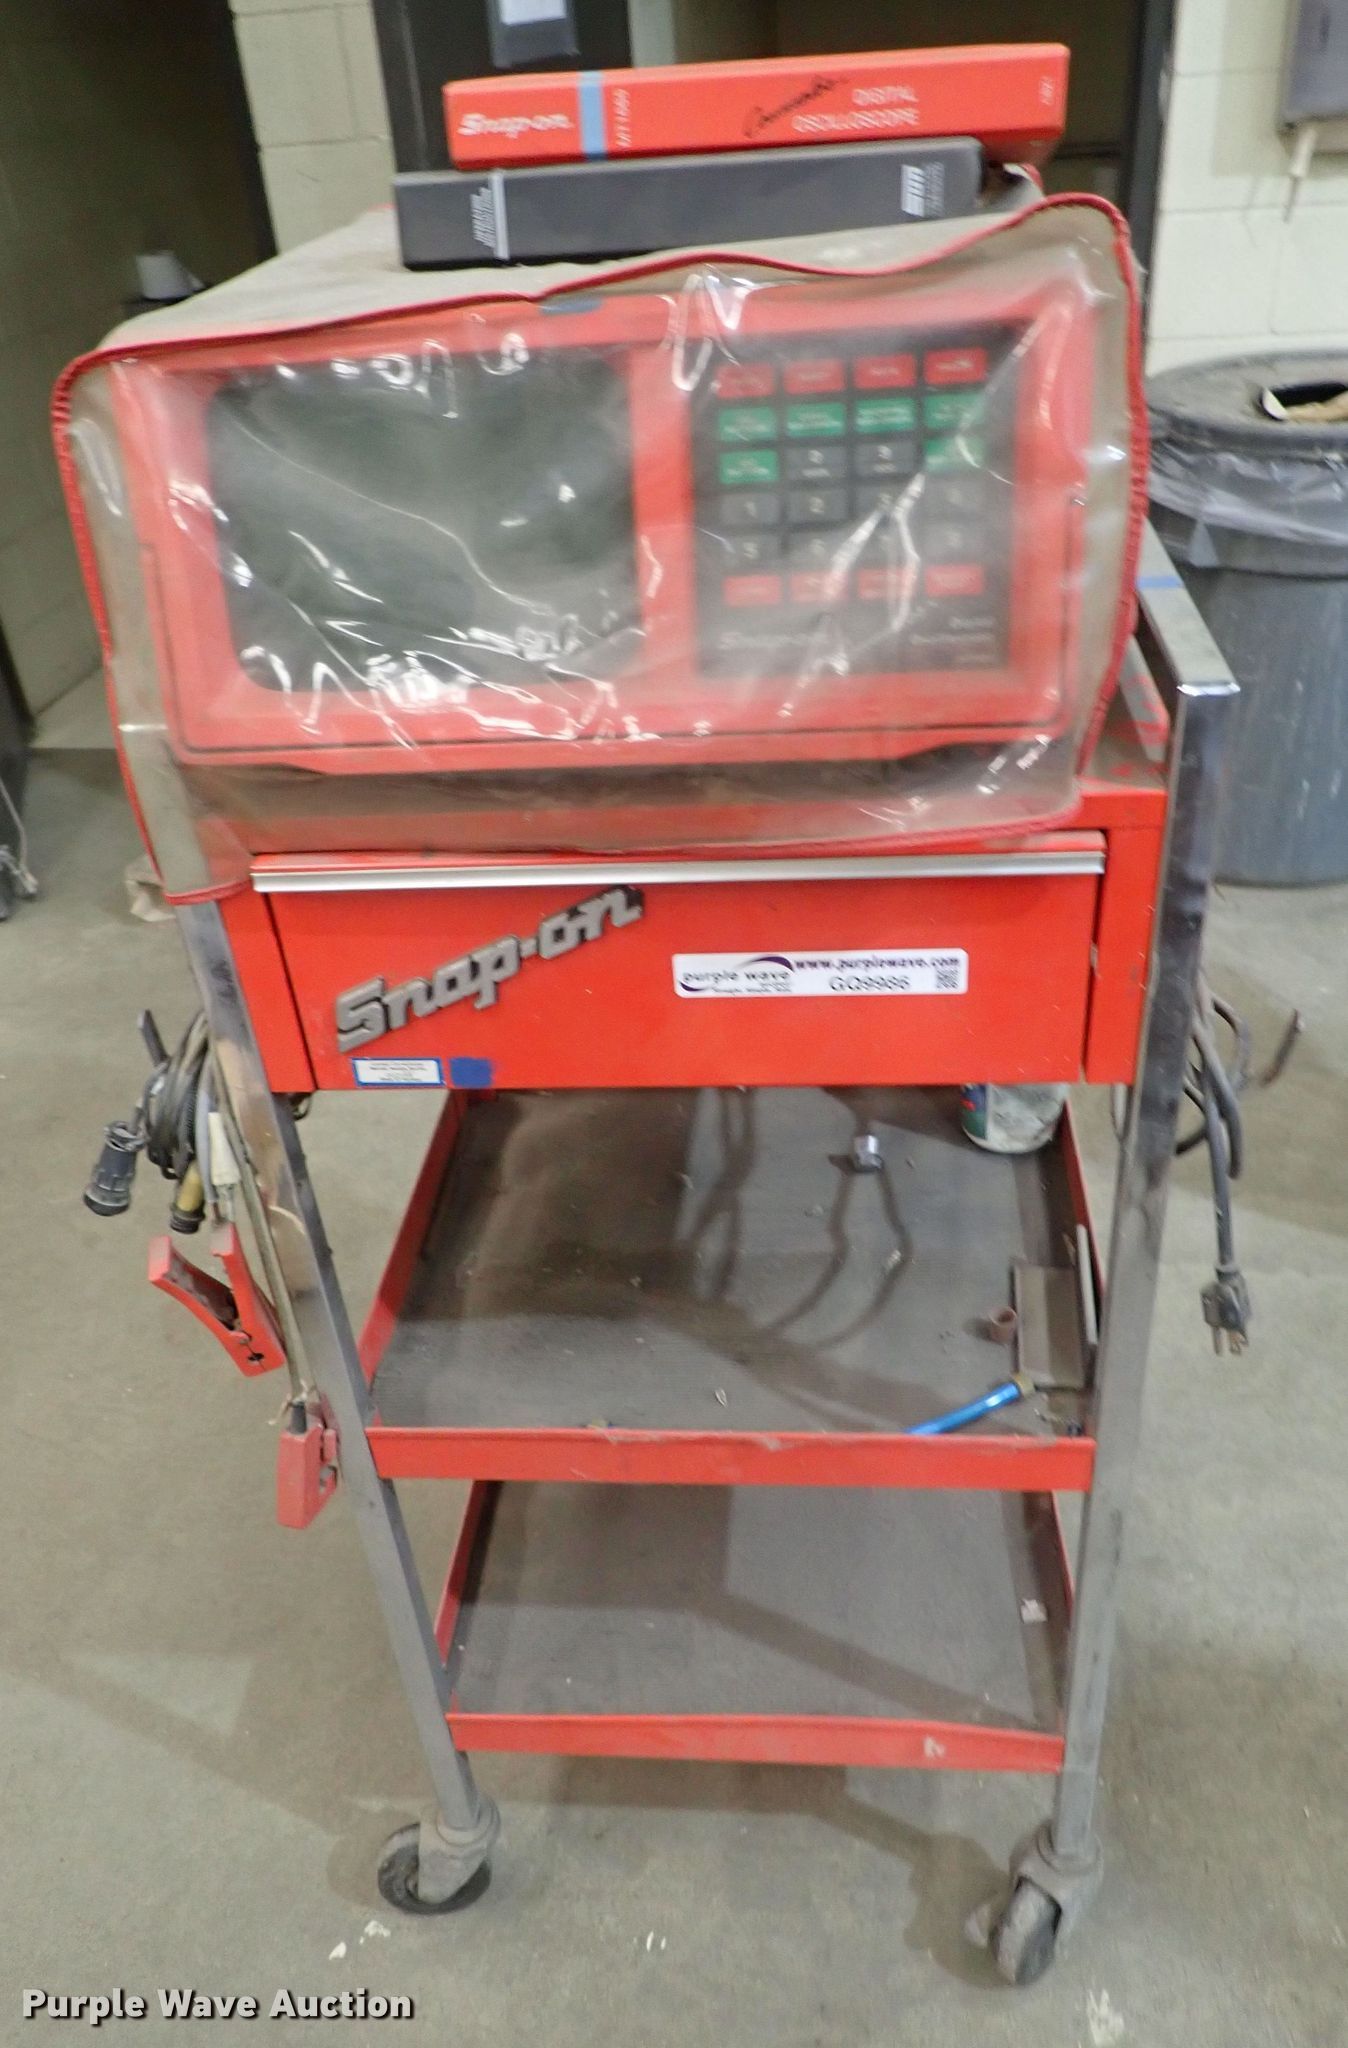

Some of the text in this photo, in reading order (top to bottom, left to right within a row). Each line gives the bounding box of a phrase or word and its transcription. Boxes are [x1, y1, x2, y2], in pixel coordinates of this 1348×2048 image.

[336, 884, 646, 1054] Snap-on
[794, 954, 960, 973] www.purplewave.com
[683, 970, 789, 985] purple wave
